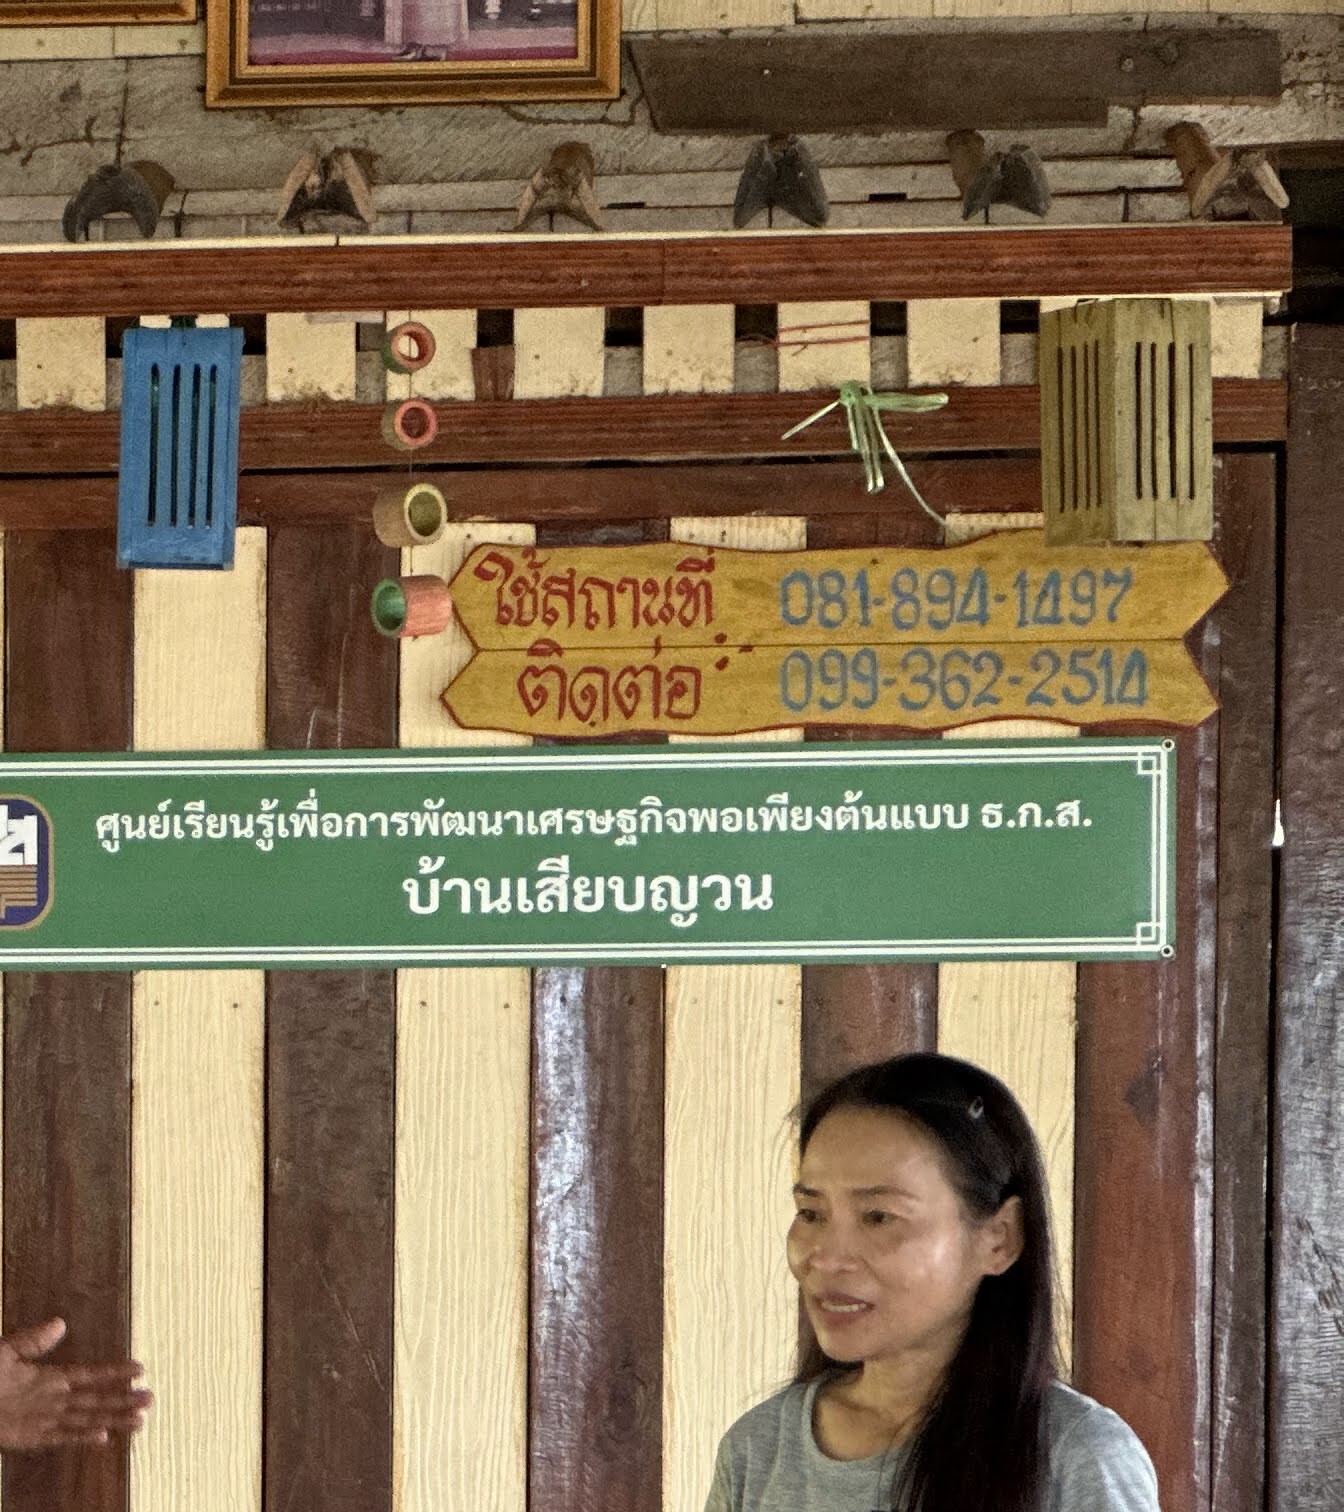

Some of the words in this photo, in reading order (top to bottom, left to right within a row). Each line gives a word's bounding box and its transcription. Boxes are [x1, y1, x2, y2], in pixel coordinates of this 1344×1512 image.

[780, 566, 1134, 631] 081-894-1497
[779, 646, 1150, 713] 099-362-2514
[95, 788, 970, 854] ศูนย์เรียนรู้เพื่อการพัฒนาเศรษฐกิจพอเพียงต้นแบบ
[980, 800, 1094, 829] ธ.ก.ส.
[402, 854, 775, 928] บ้านเสียบญวน
